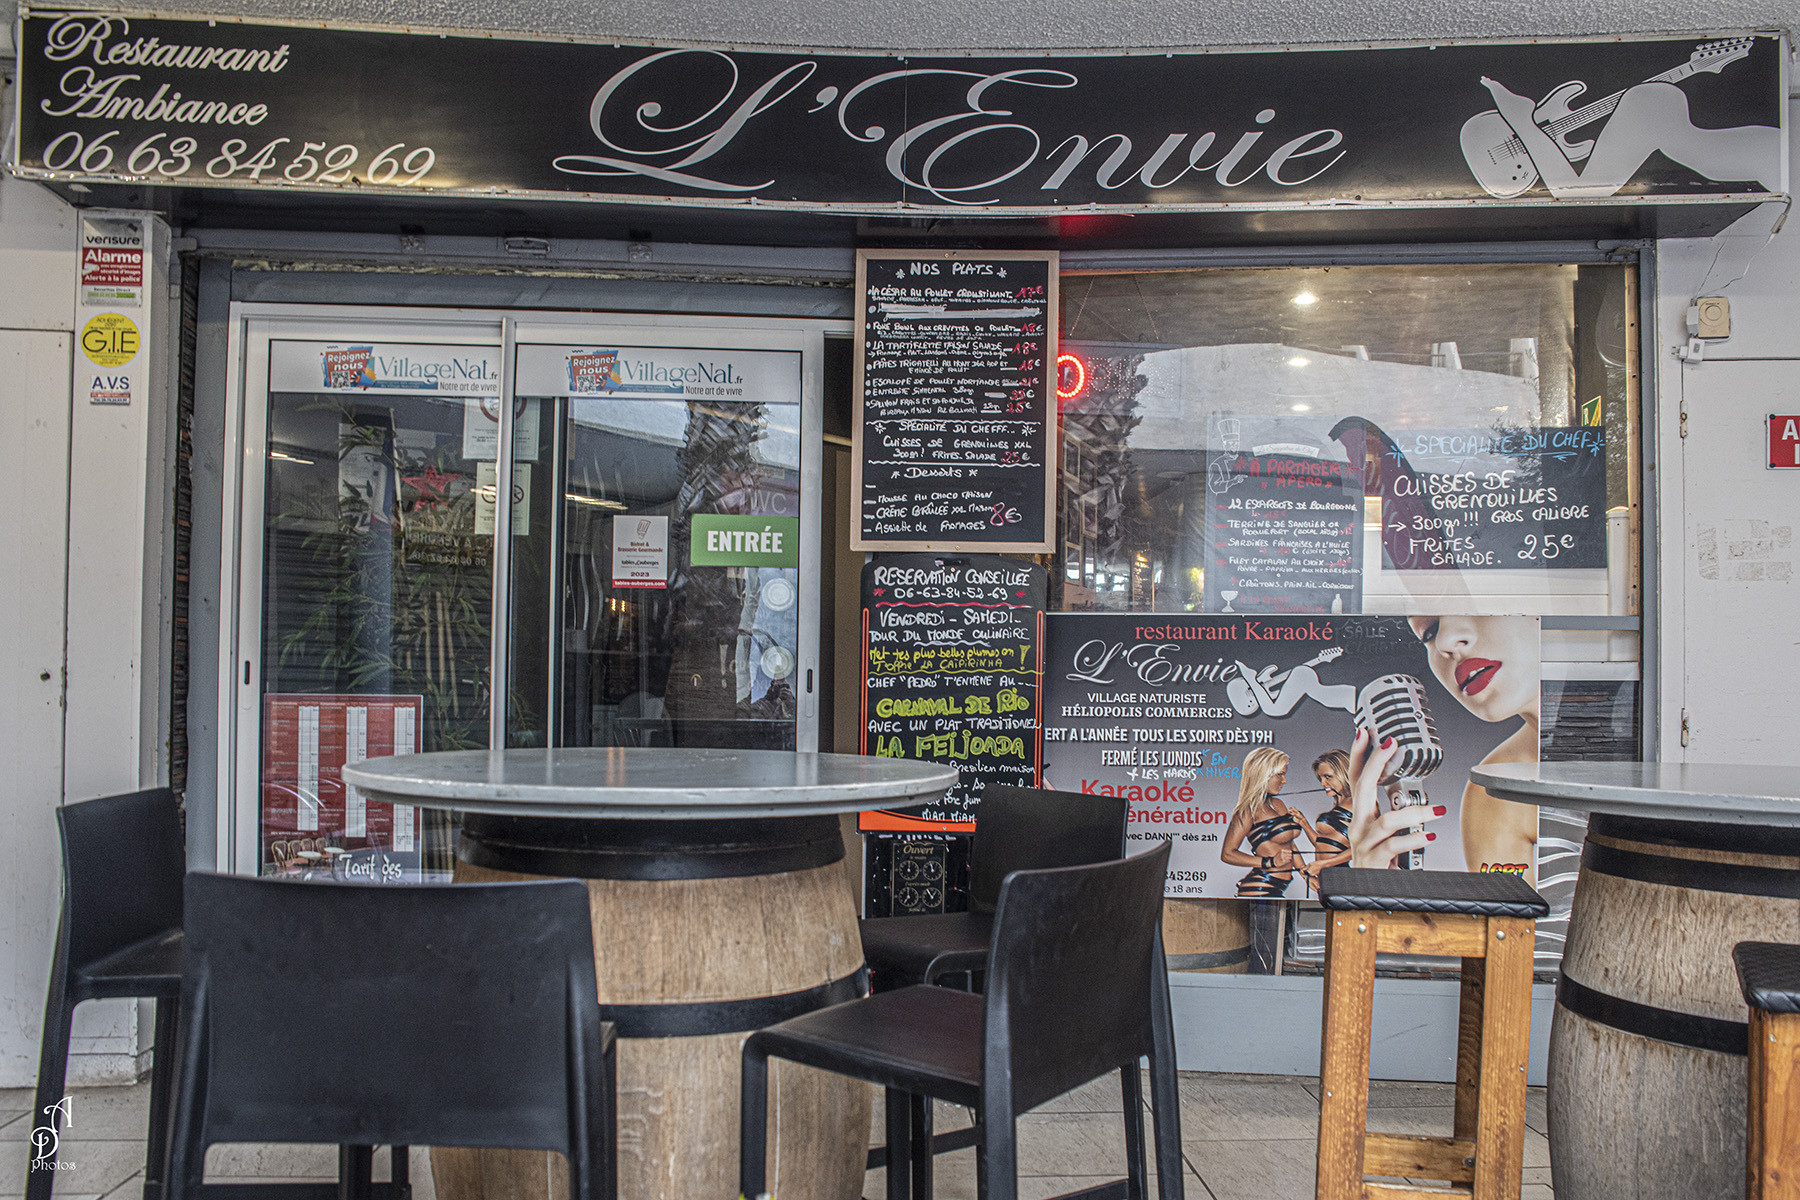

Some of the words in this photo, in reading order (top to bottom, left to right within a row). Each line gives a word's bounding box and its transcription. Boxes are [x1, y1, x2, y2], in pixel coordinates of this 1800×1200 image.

[45, 15, 290, 73] Restaurant
[40, 66, 268, 126] Ambiance
[552, 48, 1346, 206] L'Envie
[42, 131, 120, 173] 06
[127, 133, 198, 176] 63
[206, 138, 290, 179] 84
[284, 142, 359, 182] 52
[367, 144, 435, 187] 69
[86, 236, 140, 245] verisure
[85, 249, 141, 263] Alarme
[910, 262, 940, 275] NOS
[952, 262, 994, 275] PLATS
[910, 288, 922, 297] AU
[925, 288, 953, 297] POULET
[872, 340, 884, 350] LA
[972, 341, 1002, 350] SALADE
[327, 352, 370, 363] Rejoignez
[573, 355, 616, 367] Rejoignez
[334, 362, 363, 371] nous
[579, 366, 609, 375] nous
[92, 376, 130, 390] A.V.S
[440, 382, 458, 391] Notre
[460, 383, 470, 391] art
[471, 382, 479, 391] de
[480, 382, 497, 392] vivre
[685, 386, 704, 395] Notre
[705, 386, 715, 395] art
[716, 386, 725, 395] de
[726, 387, 743, 396] vivre
[883, 435, 921, 448] CUISSES
[1014, 441, 1032, 449] XXL
[1522, 433, 1548, 450] DU
[1552, 430, 1591, 448] CHEF
[965, 451, 997, 460] SALADE
[1266, 459, 1341, 478] PARTAGER
[1394, 471, 1477, 497] CUISSES
[1482, 469, 1516, 490] DE
[931, 492, 958, 501] CHOCO
[1432, 487, 1558, 511] GRENOUILLES
[1491, 510, 1524, 524] GROS
[1532, 505, 1590, 521] CALIBRE
[1227, 519, 1271, 528] TERRINE
[1273, 520, 1286, 528] DE
[1288, 520, 1326, 528] SANGLIER
[707, 526, 783, 553] ENTRÉE
[1227, 538, 1269, 547] SARDINES
[1409, 536, 1475, 554] FRITES
[1229, 556, 1250, 565] FILET
[1252, 558, 1288, 566] CATALAN
[1303, 558, 1324, 566] CHOIX
[874, 566, 960, 586] RESERVATION
[880, 608, 945, 627] VENDREDI
[869, 630, 899, 643] TOUR
[903, 630, 920, 642] DU
[927, 628, 965, 641] MONDE
[972, 627, 1030, 641] CULINAIRE
[1135, 626, 1238, 641] restaurant
[1244, 621, 1334, 641] Karaoké
[913, 646, 935, 663] plus
[938, 646, 965, 659] belles
[966, 647, 999, 661] plumes
[1065, 639, 1238, 687] L'Envie
[867, 677, 896, 688] CHEF
[876, 697, 963, 718] CARNAVAL
[965, 695, 993, 715] DE
[996, 687, 1030, 714] RIO
[1087, 692, 1137, 704] VILLAGE
[1139, 693, 1207, 704] NATURISTE
[1061, 703, 1142, 718] HÉLIOPOLIS
[1145, 706, 1233, 719] COMMERCES
[868, 719, 902, 733] AVEC
[909, 719, 928, 731] UN
[935, 718, 962, 731] PLAT
[1069, 728, 1078, 741] A
[1080, 725, 1128, 742] L'ANNÉE
[1133, 728, 1164, 742] TOUS
[1167, 729, 1187, 743] LES
[1190, 729, 1224, 743] SOIRS
[1226, 727, 1249, 743] DÈS
[1250, 730, 1273, 744] 19H
[876, 735, 905, 758] LA
[916, 729, 1025, 759] FEIJOADA
[1102, 747, 1137, 767] FERMÉ
[1140, 751, 1159, 766] LES
[1162, 751, 1202, 767] LUNDIS
[1211, 752, 1227, 765] EN
[999, 764, 1036, 774] maison
[1141, 768, 1159, 780] LES
[1206, 766, 1242, 779] HIVER
[1128, 807, 1227, 824] énération
[1126, 833, 1142, 841] vec
[1182, 832, 1199, 842] dès
[1201, 833, 1218, 842] 21h
[339, 854, 375, 879] Tarif
[1172, 885, 1184, 894] 18
[1185, 886, 1203, 894] ans
